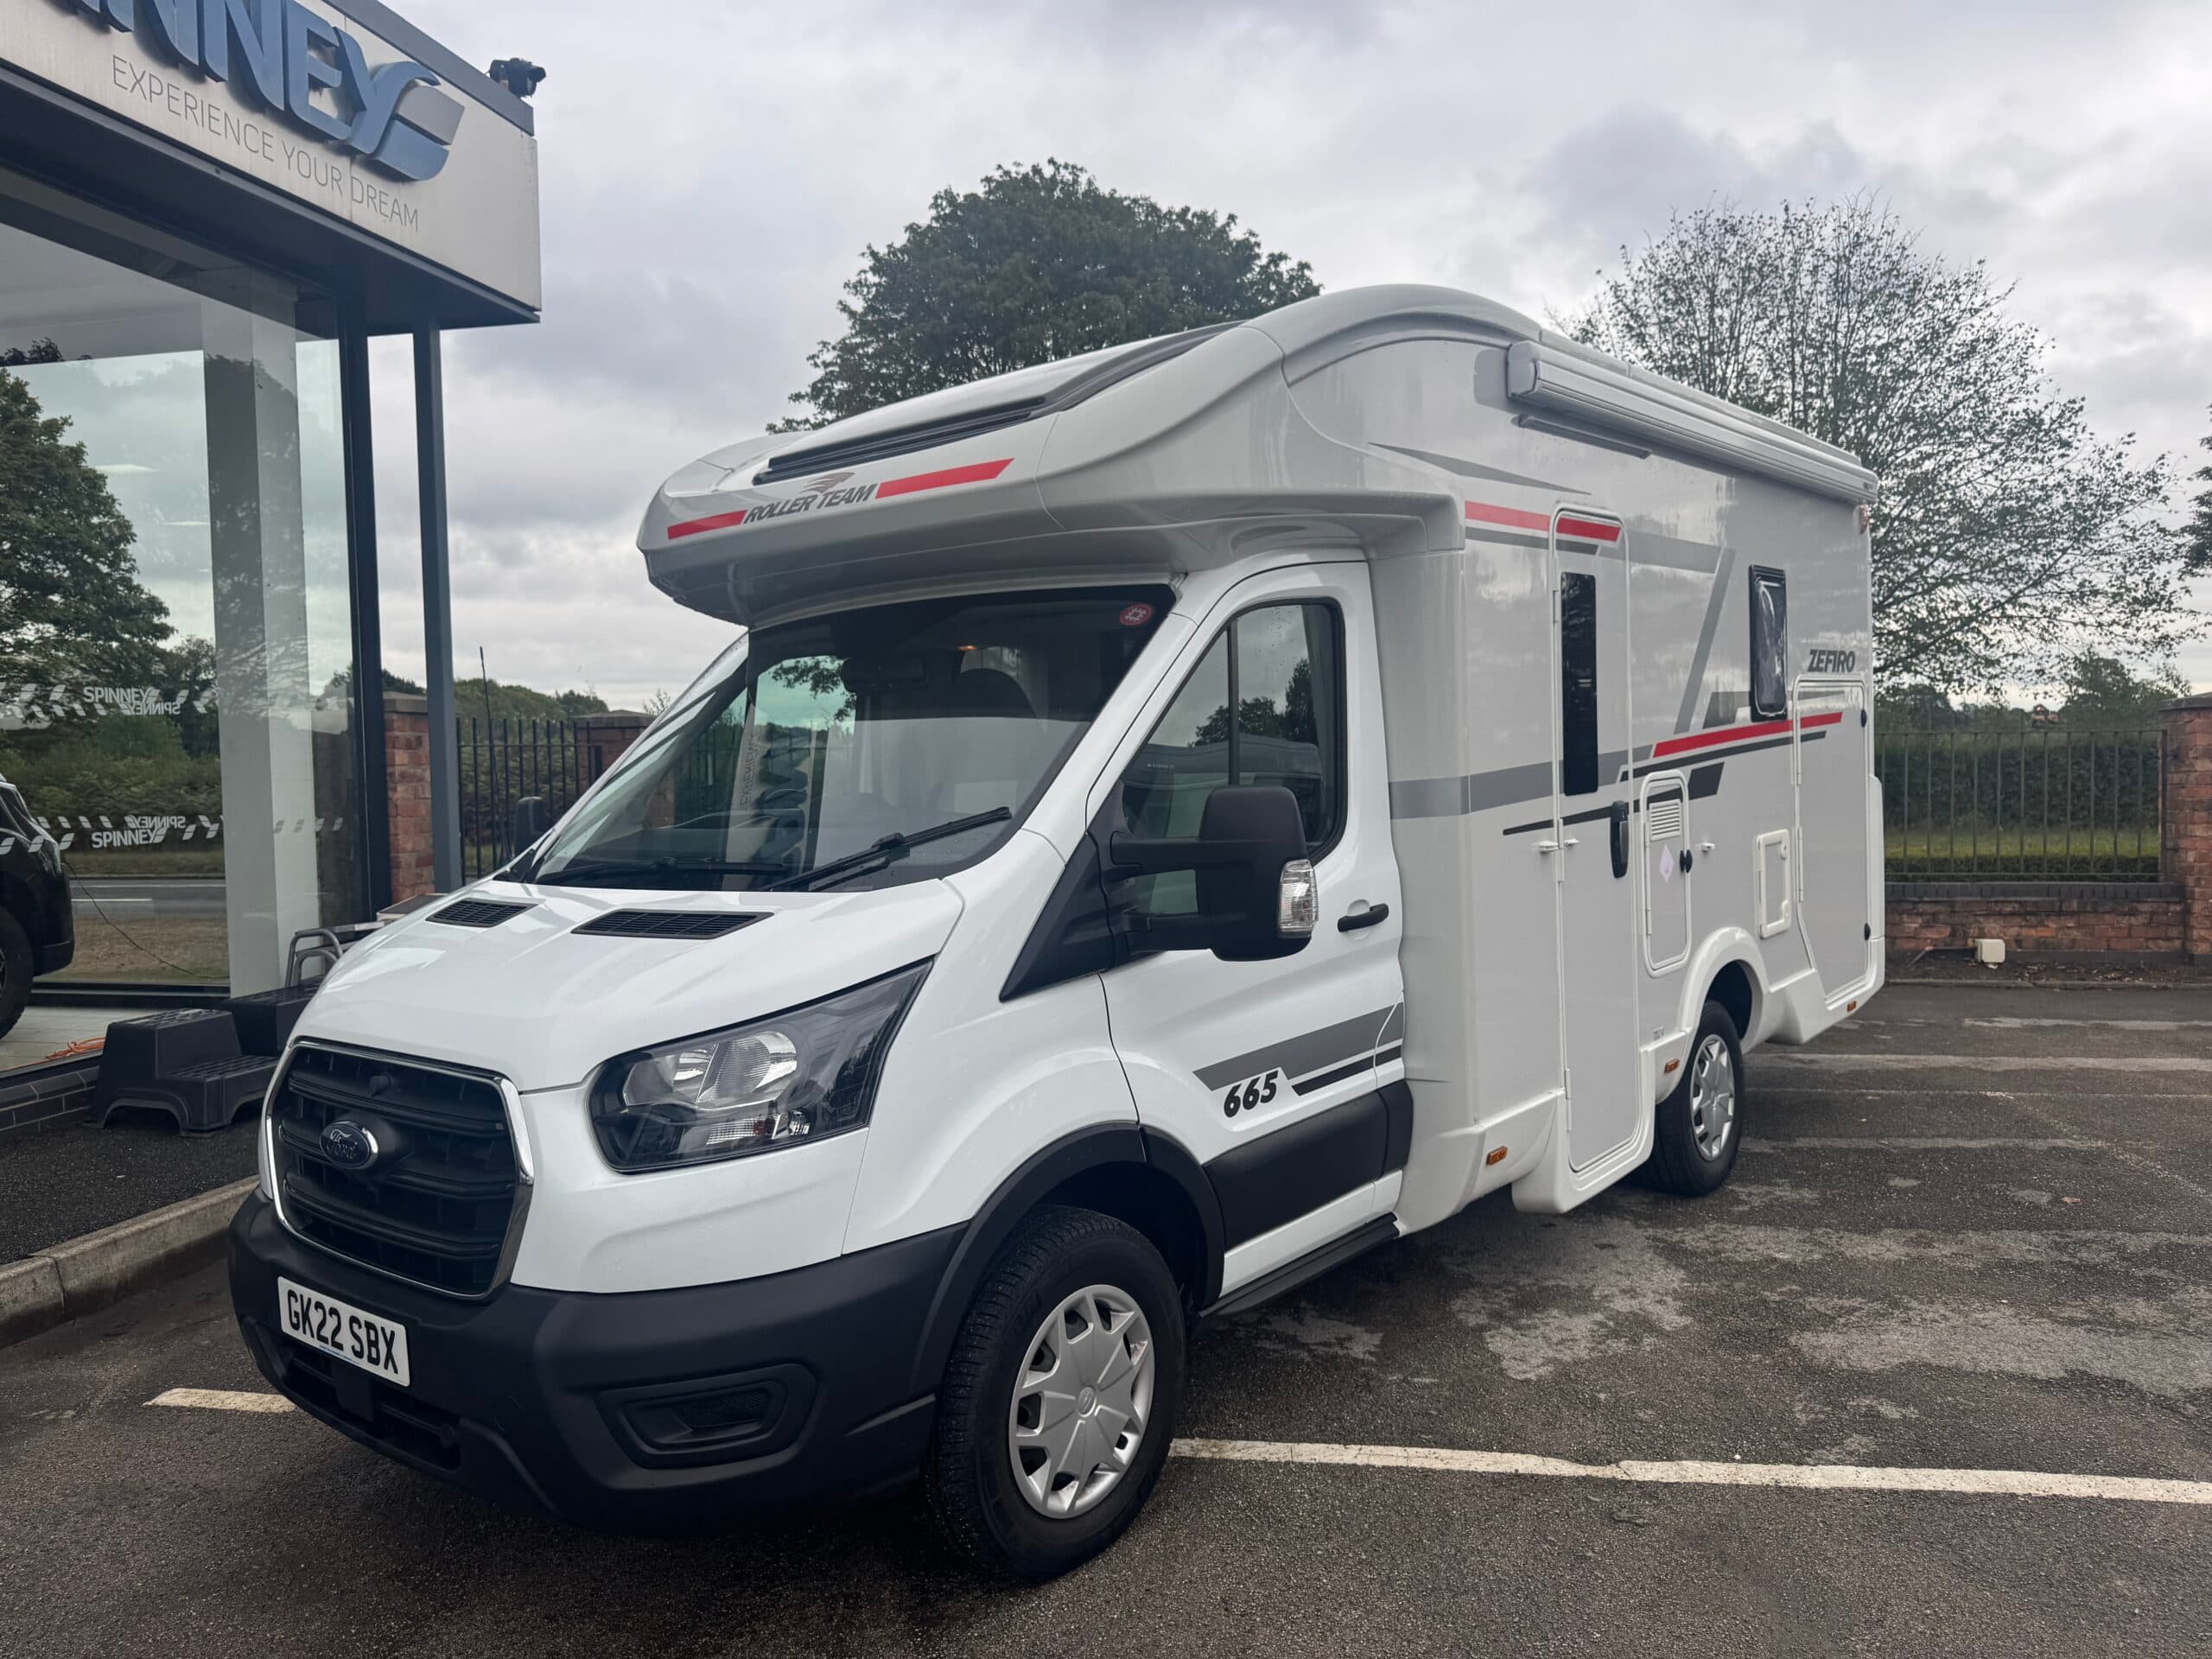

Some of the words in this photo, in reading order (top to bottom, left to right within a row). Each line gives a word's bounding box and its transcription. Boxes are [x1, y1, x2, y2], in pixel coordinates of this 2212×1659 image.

[82, 0, 442, 156] NNEY
[112, 54, 275, 162] EXPERIENCE
[282, 139, 343, 196] YOUR
[350, 175, 419, 233] DREAM
[743, 493, 818, 524] ROLLER
[817, 483, 879, 510] TEAM
[1807, 649, 1856, 672] ZEFIRO
[83, 686, 157, 704] SPINNEY
[91, 828, 164, 849] SPINNEY
[1224, 1070, 1279, 1118] 665
[287, 1288, 344, 1352] GK22
[348, 1314, 399, 1375] SBX
